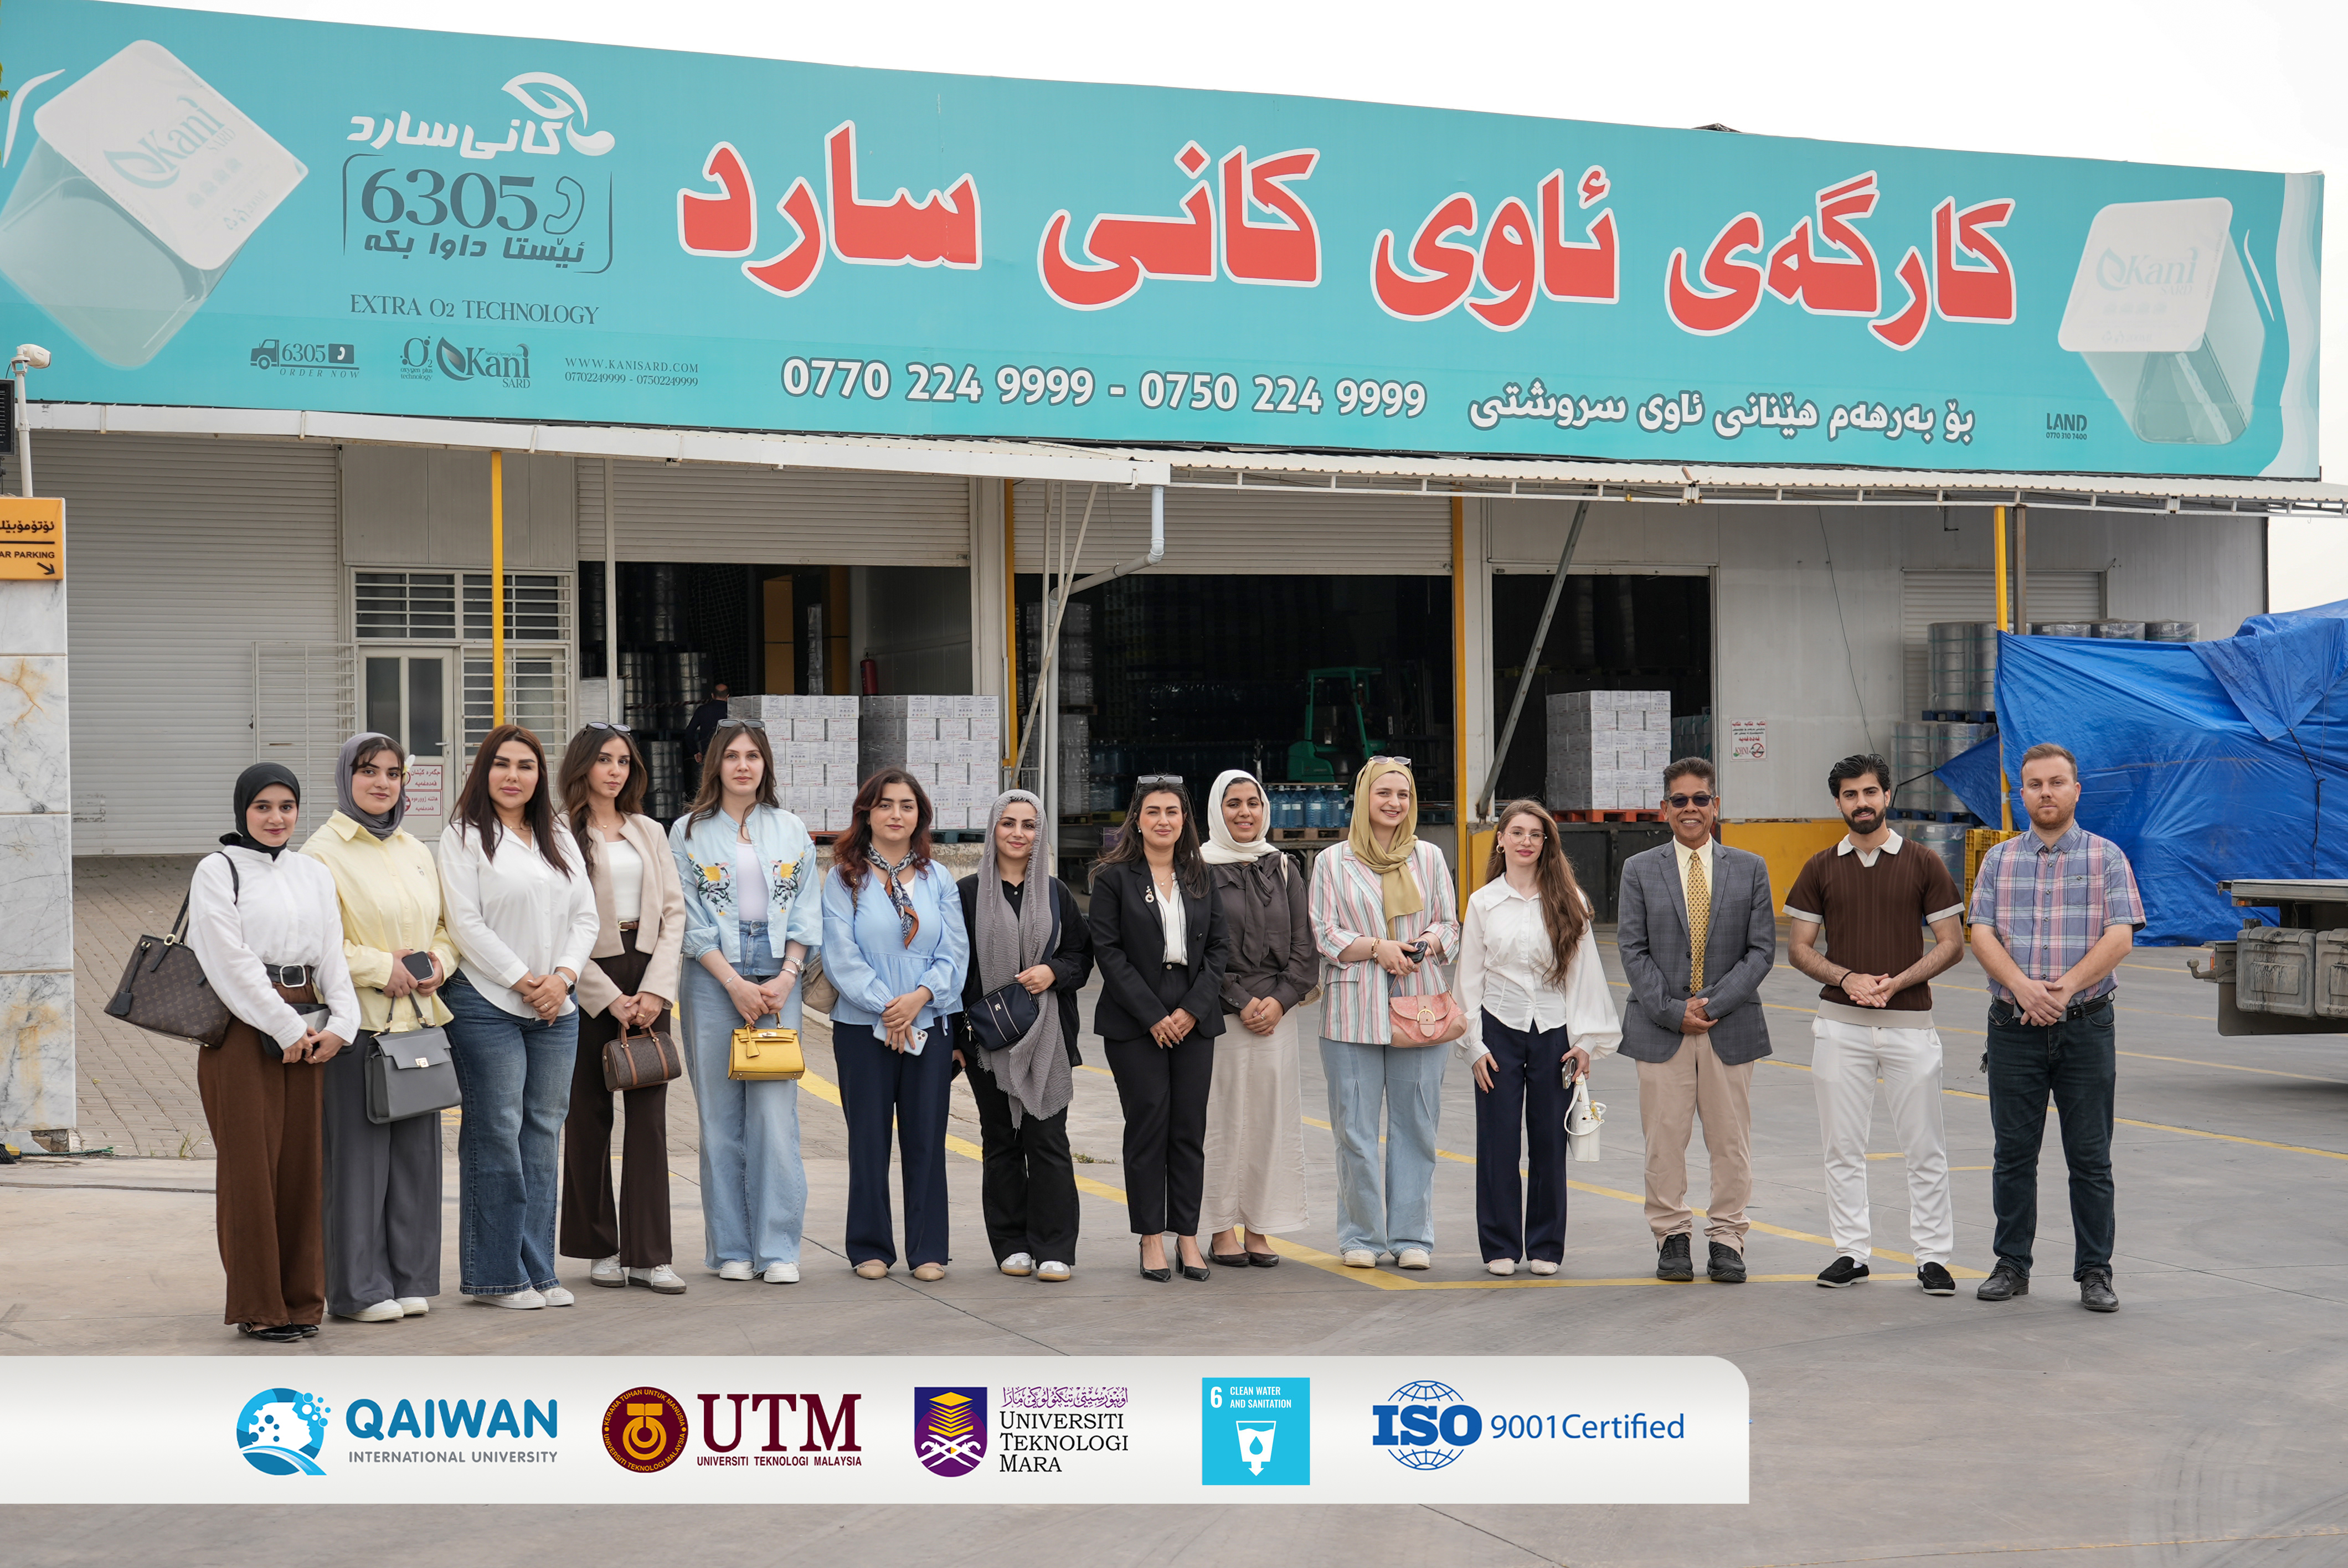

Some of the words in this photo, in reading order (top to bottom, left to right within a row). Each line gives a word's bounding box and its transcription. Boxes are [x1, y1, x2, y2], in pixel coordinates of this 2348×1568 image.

[347, 110, 458, 149] سارد
[362, 168, 538, 231] 6305
[677, 120, 982, 298] سارد
[1037, 140, 1322, 311] کانی
[429, 233, 487, 260] داوا
[1370, 165, 1619, 332] ئاوی
[351, 294, 422, 316] EXTRA
[430, 298, 455, 317] O2
[462, 300, 599, 324] TECHNOLOGY
[282, 343, 326, 362] 6305
[565, 358, 699, 373] WWW.KANISARD.COM
[280, 368, 323, 377] ORDER
[331, 370, 359, 378] NOW
[503, 378, 531, 389] SARD
[565, 372, 626, 383] 07702249999
[637, 375, 698, 387] 07502249999
[781, 356, 891, 400] 0770
[905, 362, 984, 403] 224
[995, 365, 1095, 406] 9999
[1139, 370, 1239, 411] 0750
[1252, 375, 1324, 415] 224
[1333, 378, 1427, 419] 9999
[2047, 412, 2087, 431] LAND
[0, 520, 54, 533] ئۆتۆمۆبێل
